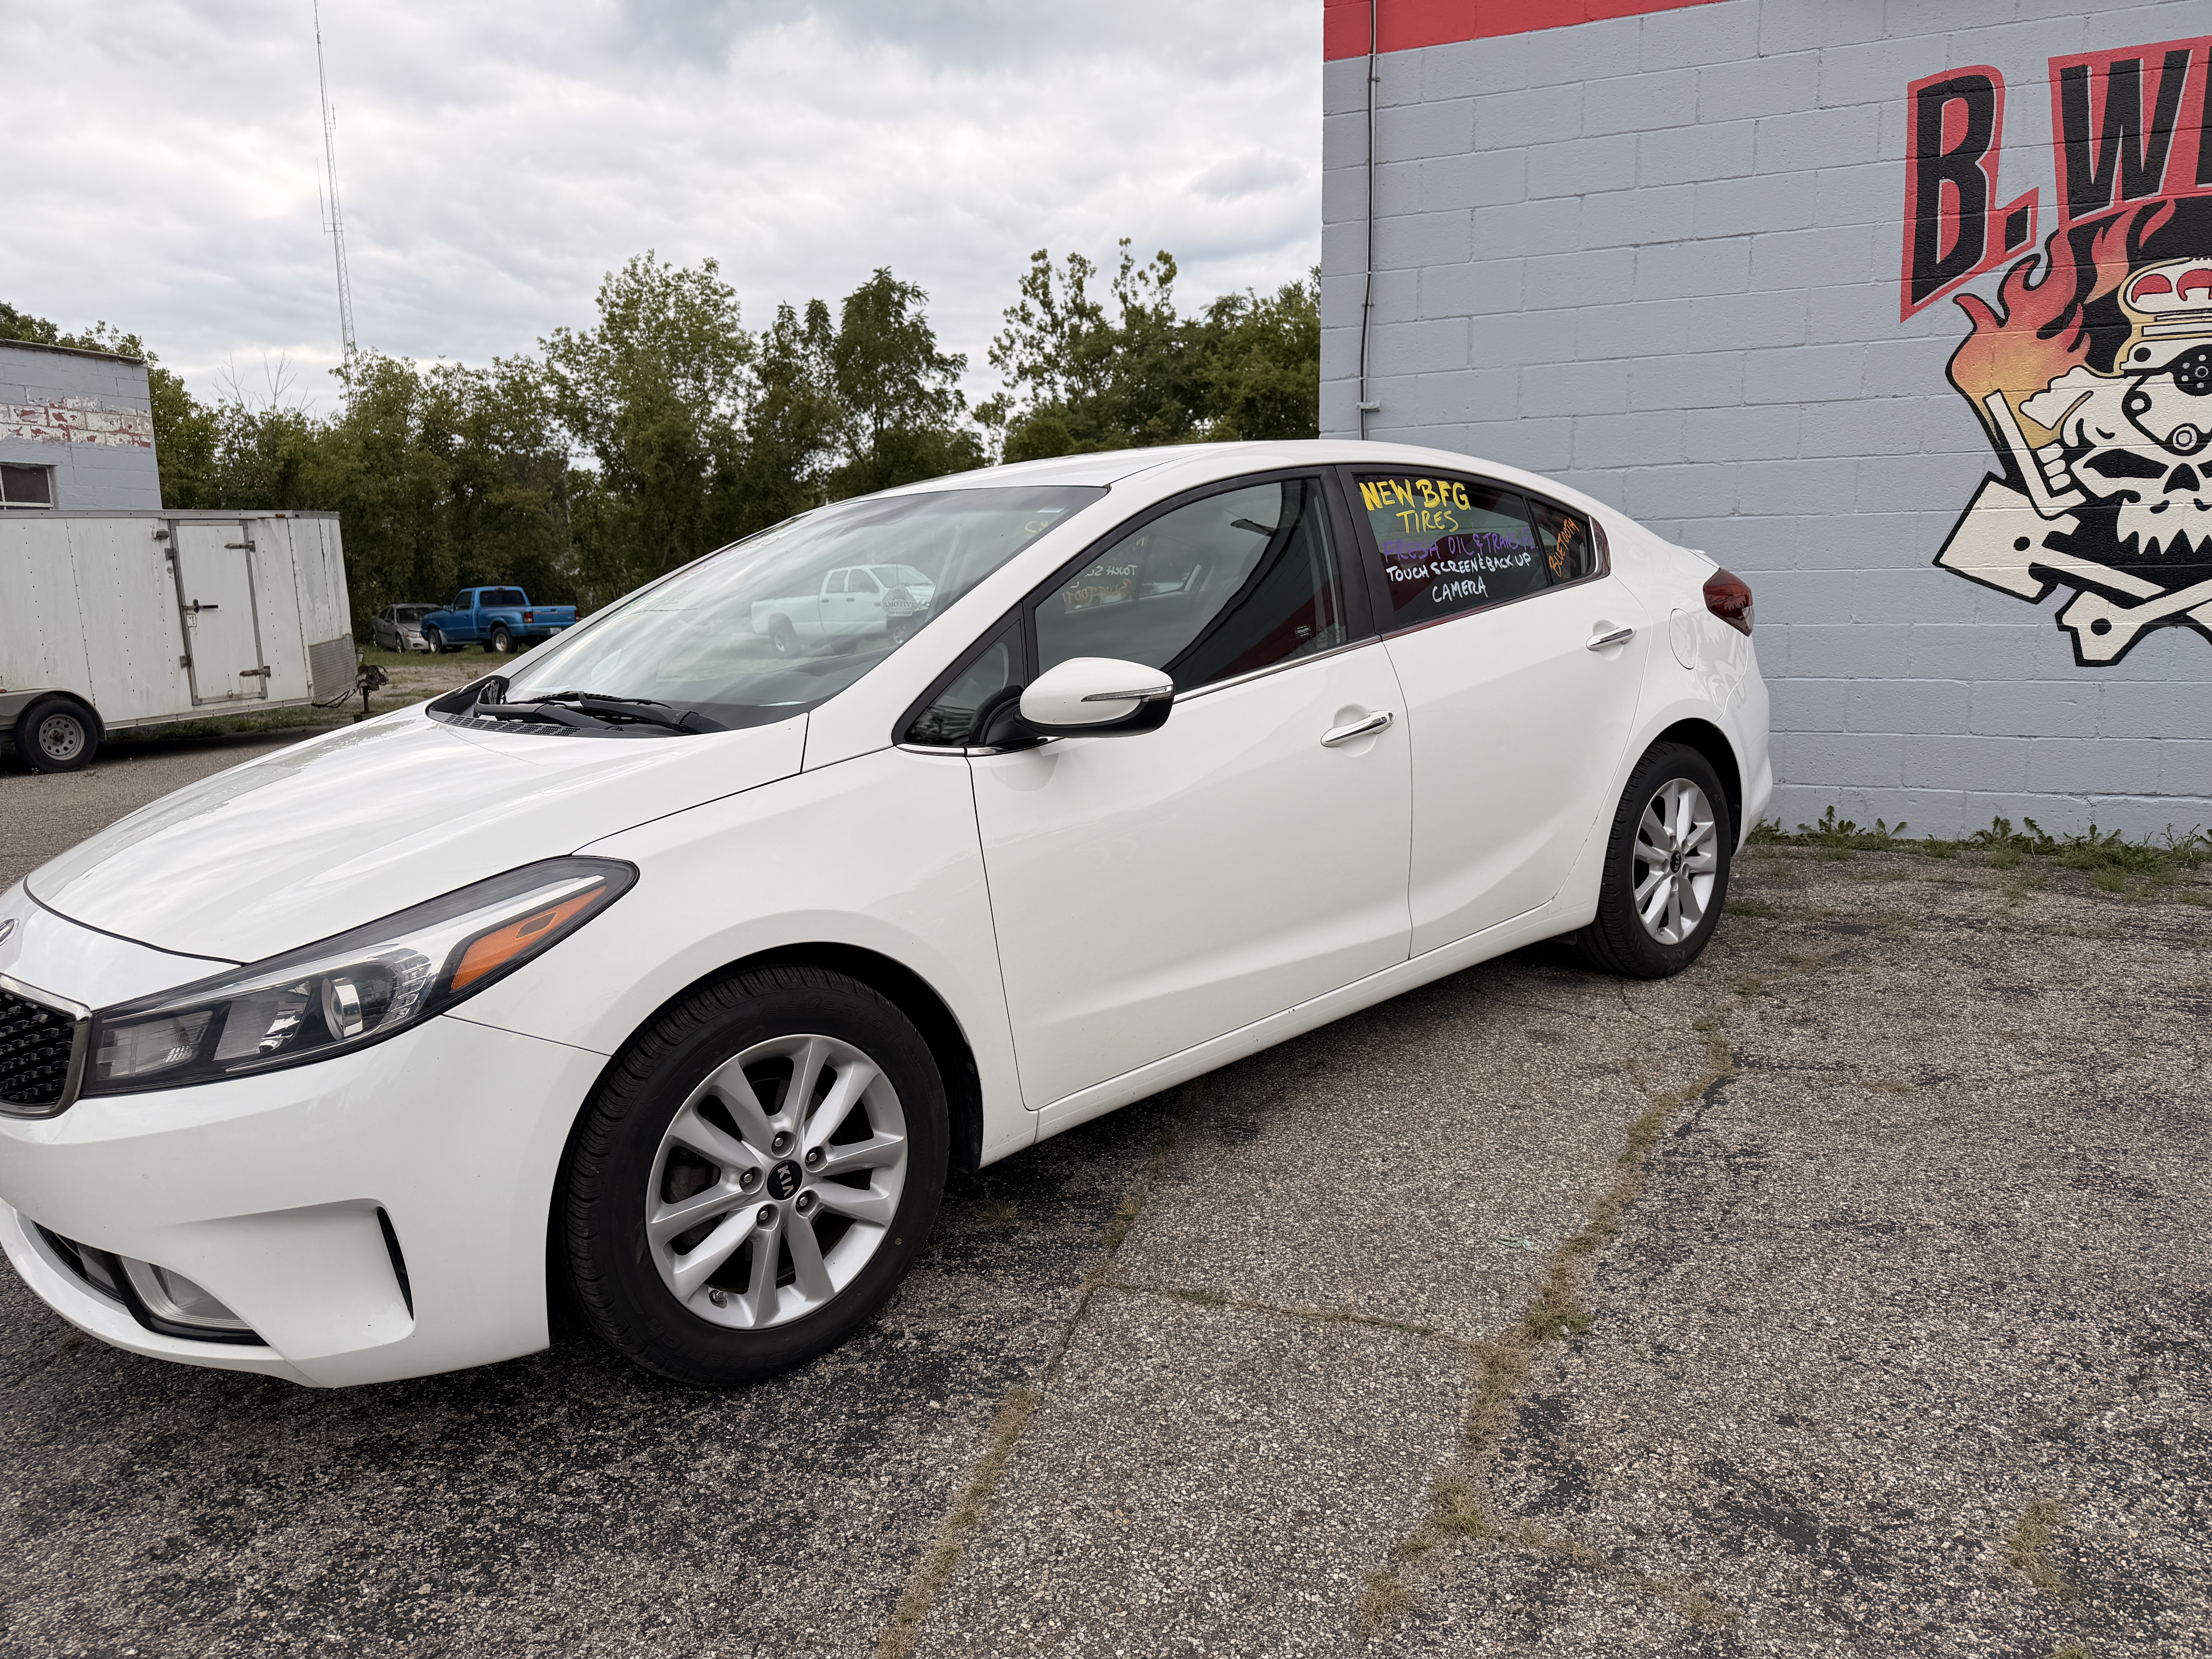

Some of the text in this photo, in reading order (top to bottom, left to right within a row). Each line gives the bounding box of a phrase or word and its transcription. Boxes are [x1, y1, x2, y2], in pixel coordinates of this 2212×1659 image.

[2059, 46, 2212, 222] W
[1359, 479, 1471, 511] NEW BFG
[1396, 510, 1460, 534] TIRES
[1383, 539, 1441, 563] FRESH
[1448, 536, 1475, 556] OIL
[1482, 532, 1519, 554] TRANS
[1549, 517, 1580, 577] BLUETOOTH
[1386, 564, 1430, 581] TOUCH
[1431, 557, 1478, 575] SCREEN
[1486, 554, 1513, 572] BACK
[1515, 552, 1531, 567] UP
[1432, 575, 1488, 603] CAMERA
[778, 1164, 794, 1197] KIA
